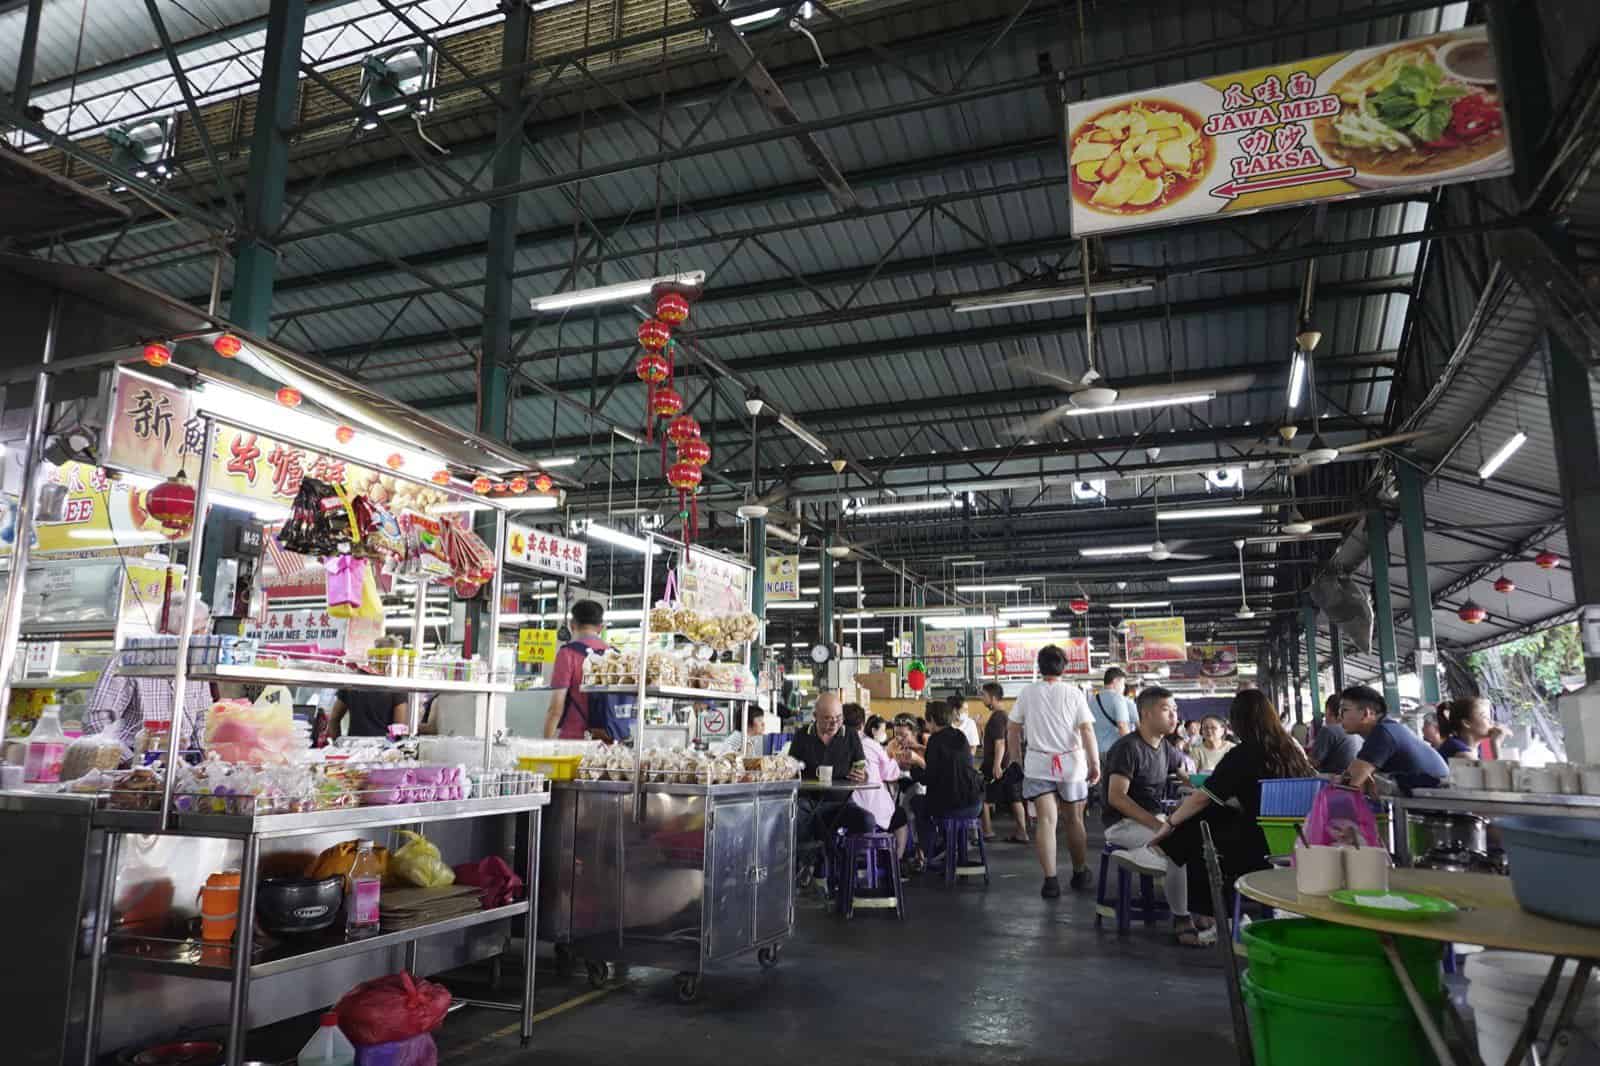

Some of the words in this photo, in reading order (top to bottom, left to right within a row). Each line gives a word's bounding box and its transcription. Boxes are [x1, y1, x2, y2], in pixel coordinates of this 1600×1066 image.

[1223, 73, 1314, 109] 爪哇面
[1206, 107, 1277, 133] JAWA
[1282, 96, 1338, 121] MEE
[1243, 125, 1304, 154] 叻沙
[1235, 149, 1318, 176] LAKSA
[243, 531, 259, 546] M-92
[774, 581, 794, 593] CAFE
